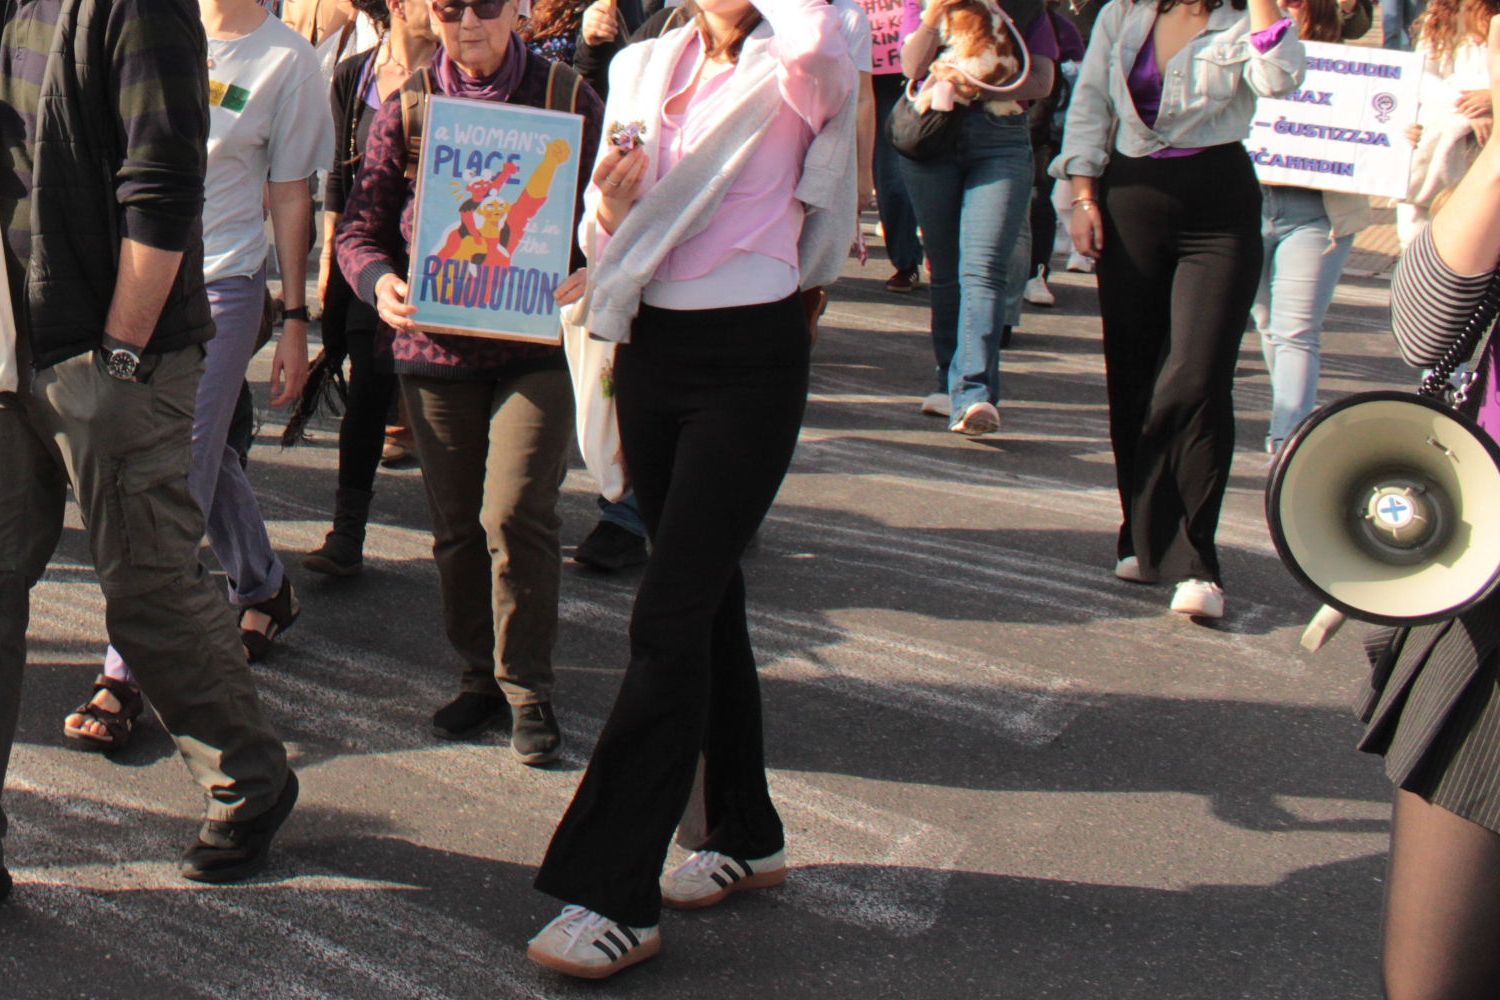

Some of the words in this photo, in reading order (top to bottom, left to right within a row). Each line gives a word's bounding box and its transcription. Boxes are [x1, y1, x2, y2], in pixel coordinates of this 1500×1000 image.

[434, 126, 449, 142] a
[454, 123, 551, 155] WOMAN'S
[1274, 116, 1391, 148] ĠUSTIZZJA
[433, 144, 521, 185] PLACE
[523, 217, 537, 233] is
[541, 219, 561, 236] in
[519, 238, 550, 255] the
[420, 254, 559, 316] REVOLUTION
